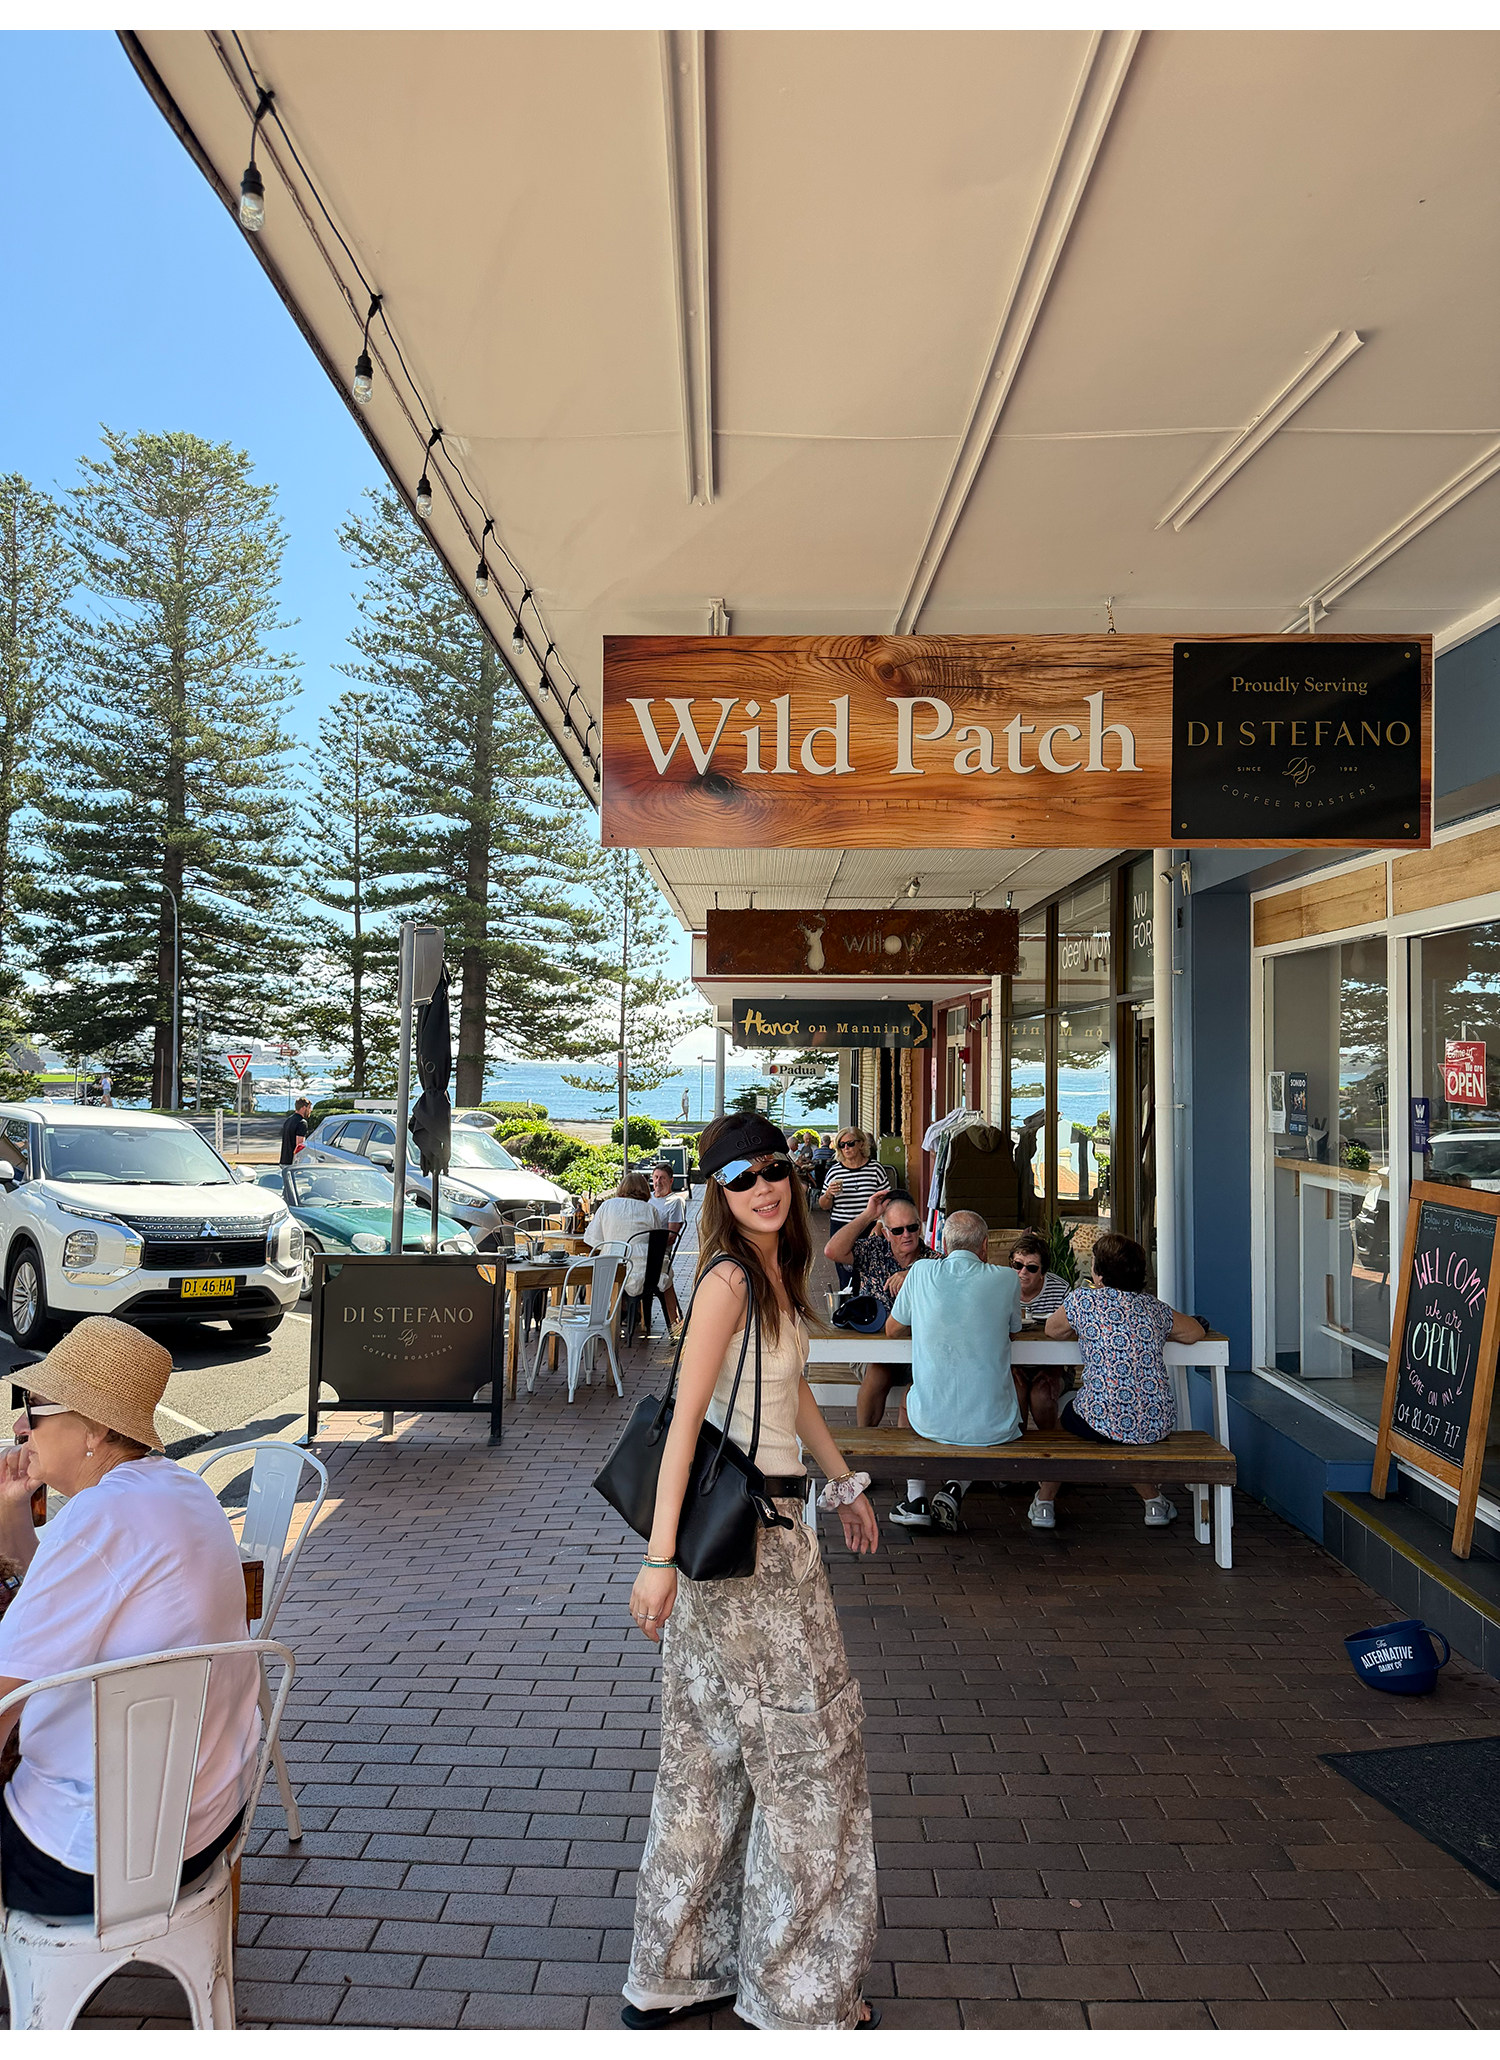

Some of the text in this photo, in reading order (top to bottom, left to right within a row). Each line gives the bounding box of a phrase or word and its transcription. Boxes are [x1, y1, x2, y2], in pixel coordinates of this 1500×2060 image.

[1231, 676, 1368, 695] Proudly Serving
[625, 690, 1144, 776] Wild Patch
[1187, 721, 1411, 746] DI STEFANO
[1221, 783, 1377, 808] COFFEE ROASTERS
[1133, 891, 1148, 920] NU
[1133, 919, 1155, 950] FOR
[738, 1008, 911, 1036] Hanoi on Manning
[779, 1064, 817, 1076] Padua
[1465, 1062, 1483, 1073] We are
[1447, 1071, 1484, 1099] OPEN
[735, 1130, 762, 1150] alo
[184, 1279, 232, 1293] DI 46 HA
[1414, 1247, 1487, 1318] WELCOME
[343, 1307, 473, 1323] DI STEFANO
[1445, 1309, 1463, 1333] are
[362, 1344, 453, 1361] COFFEE ROASTERS
[1412, 1321, 1461, 1375] OPEN
[1408, 1369, 1455, 1407] COME ON IN!
[1397, 1403, 1461, 1449] 04 81 257 717
[1375, 1639, 1387, 1649] The
[1360, 1646, 1414, 1669] ALTERNATIVE
[1378, 1663, 1395, 1673] DAIRY
